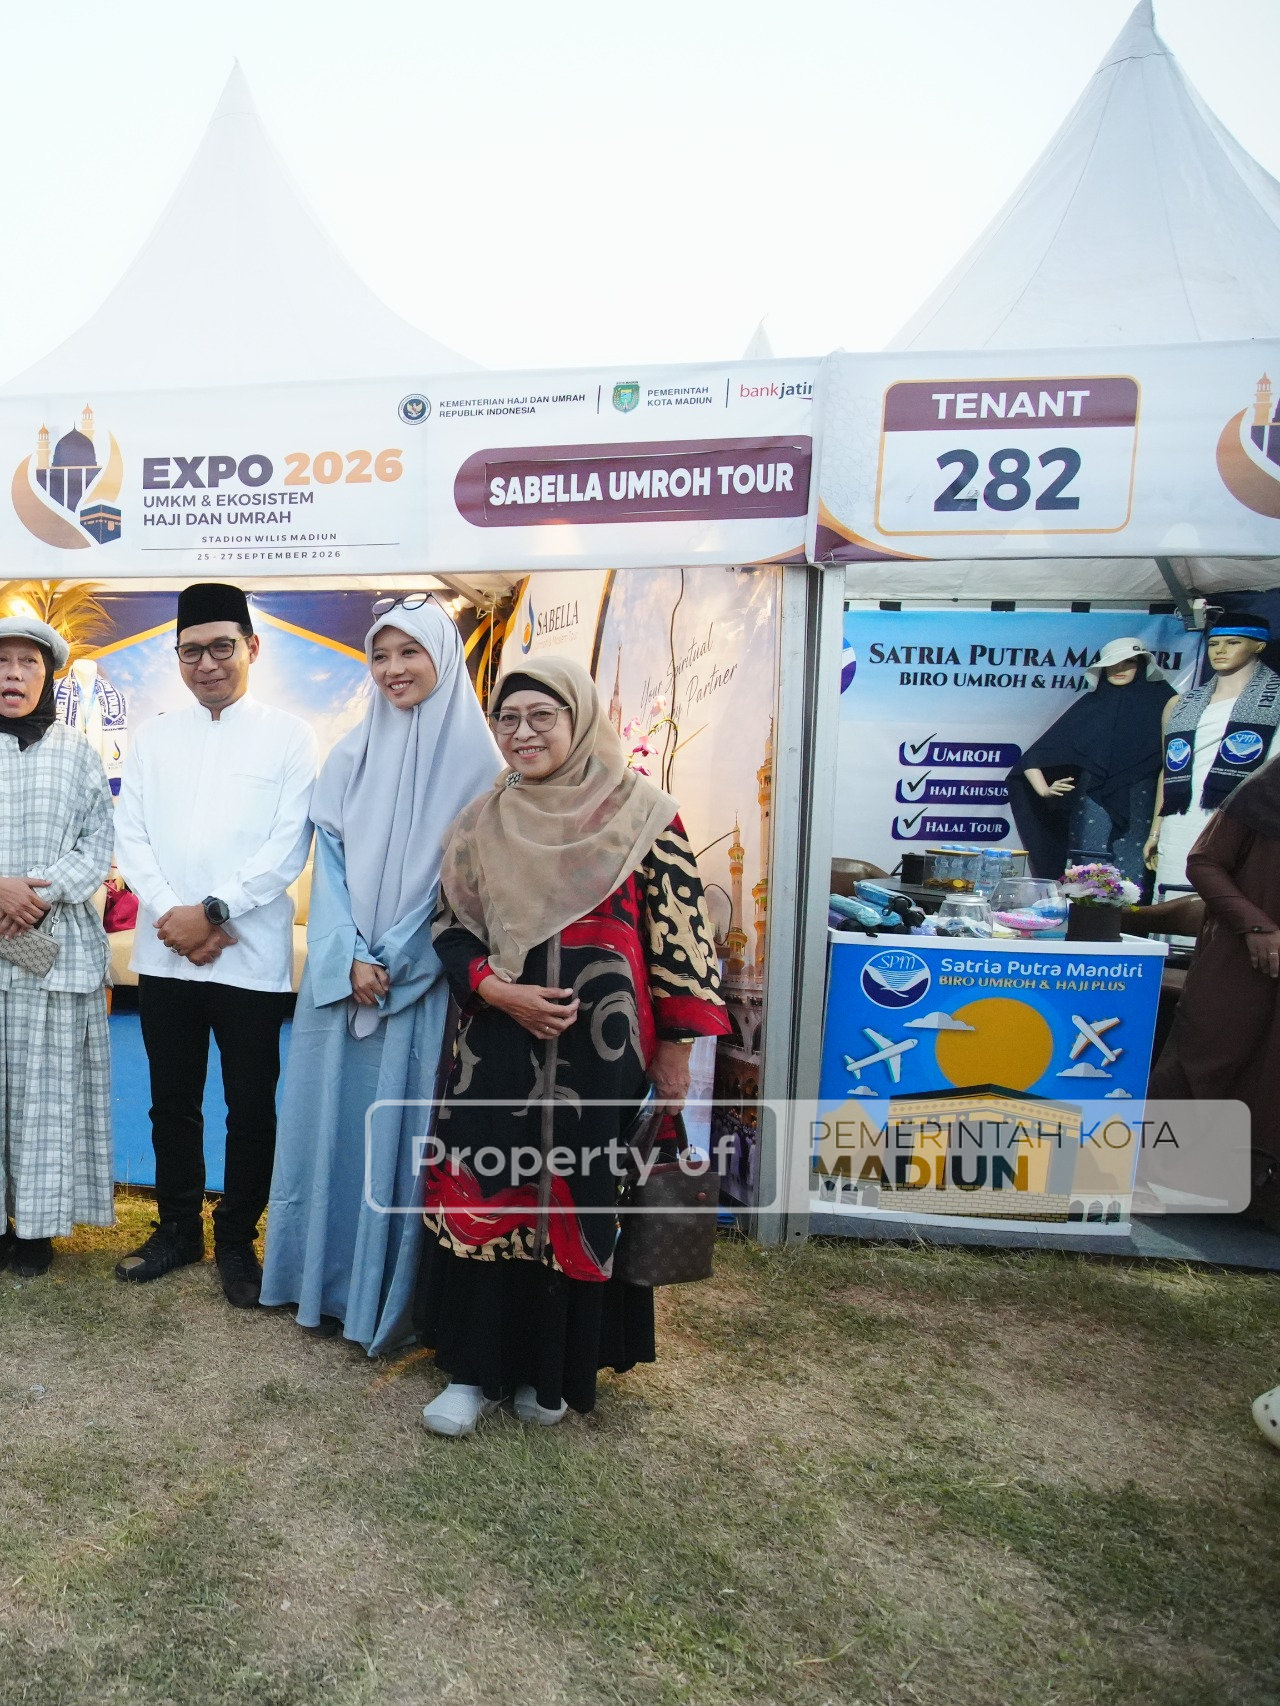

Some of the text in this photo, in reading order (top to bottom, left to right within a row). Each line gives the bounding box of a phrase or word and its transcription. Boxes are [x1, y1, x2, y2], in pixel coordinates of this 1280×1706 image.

[647, 386, 709, 397] PEMERINTAH
[439, 394, 586, 408] KEMENTERIAN HAJI DAN UMRAH
[647, 396, 713, 407] KOTA MADIUN
[931, 390, 1091, 421] TENANT
[439, 406, 536, 418] REPUBLIK INDONESIA
[142, 448, 404, 490] EXPO 2026
[489, 461, 795, 507] SABELLA UMROH TOUR
[933, 446, 1083, 513] 282
[143, 491, 314, 508] UMKM & EKOSISTEM
[143, 511, 292, 527] HAJI DAN UMRAH
[201, 533, 337, 543] STADION WILIS MADIUN
[197, 553, 210, 561] 25
[220, 552, 233, 560] 27
[236, 552, 308, 560] SEPTEMBER
[312, 550, 341, 559] 2026
[536, 600, 579, 636] SABELLA
[869, 643, 961, 665] SATRIA
[969, 644, 1056, 667] PUTRA
[900, 672, 948, 686] BIRO
[954, 672, 1028, 688] UMROH
[1031, 675, 1046, 689] &
[685, 663, 739, 717] Partner
[932, 747, 1001, 763] UMROH
[930, 785, 1009, 798] HAJI KHUSUS
[926, 821, 1003, 833] HALAL TOUR
[941, 958, 1143, 978] Satria Putra Mandiri
[939, 975, 1126, 992] BIRO UMROH & HAJI PLUS
